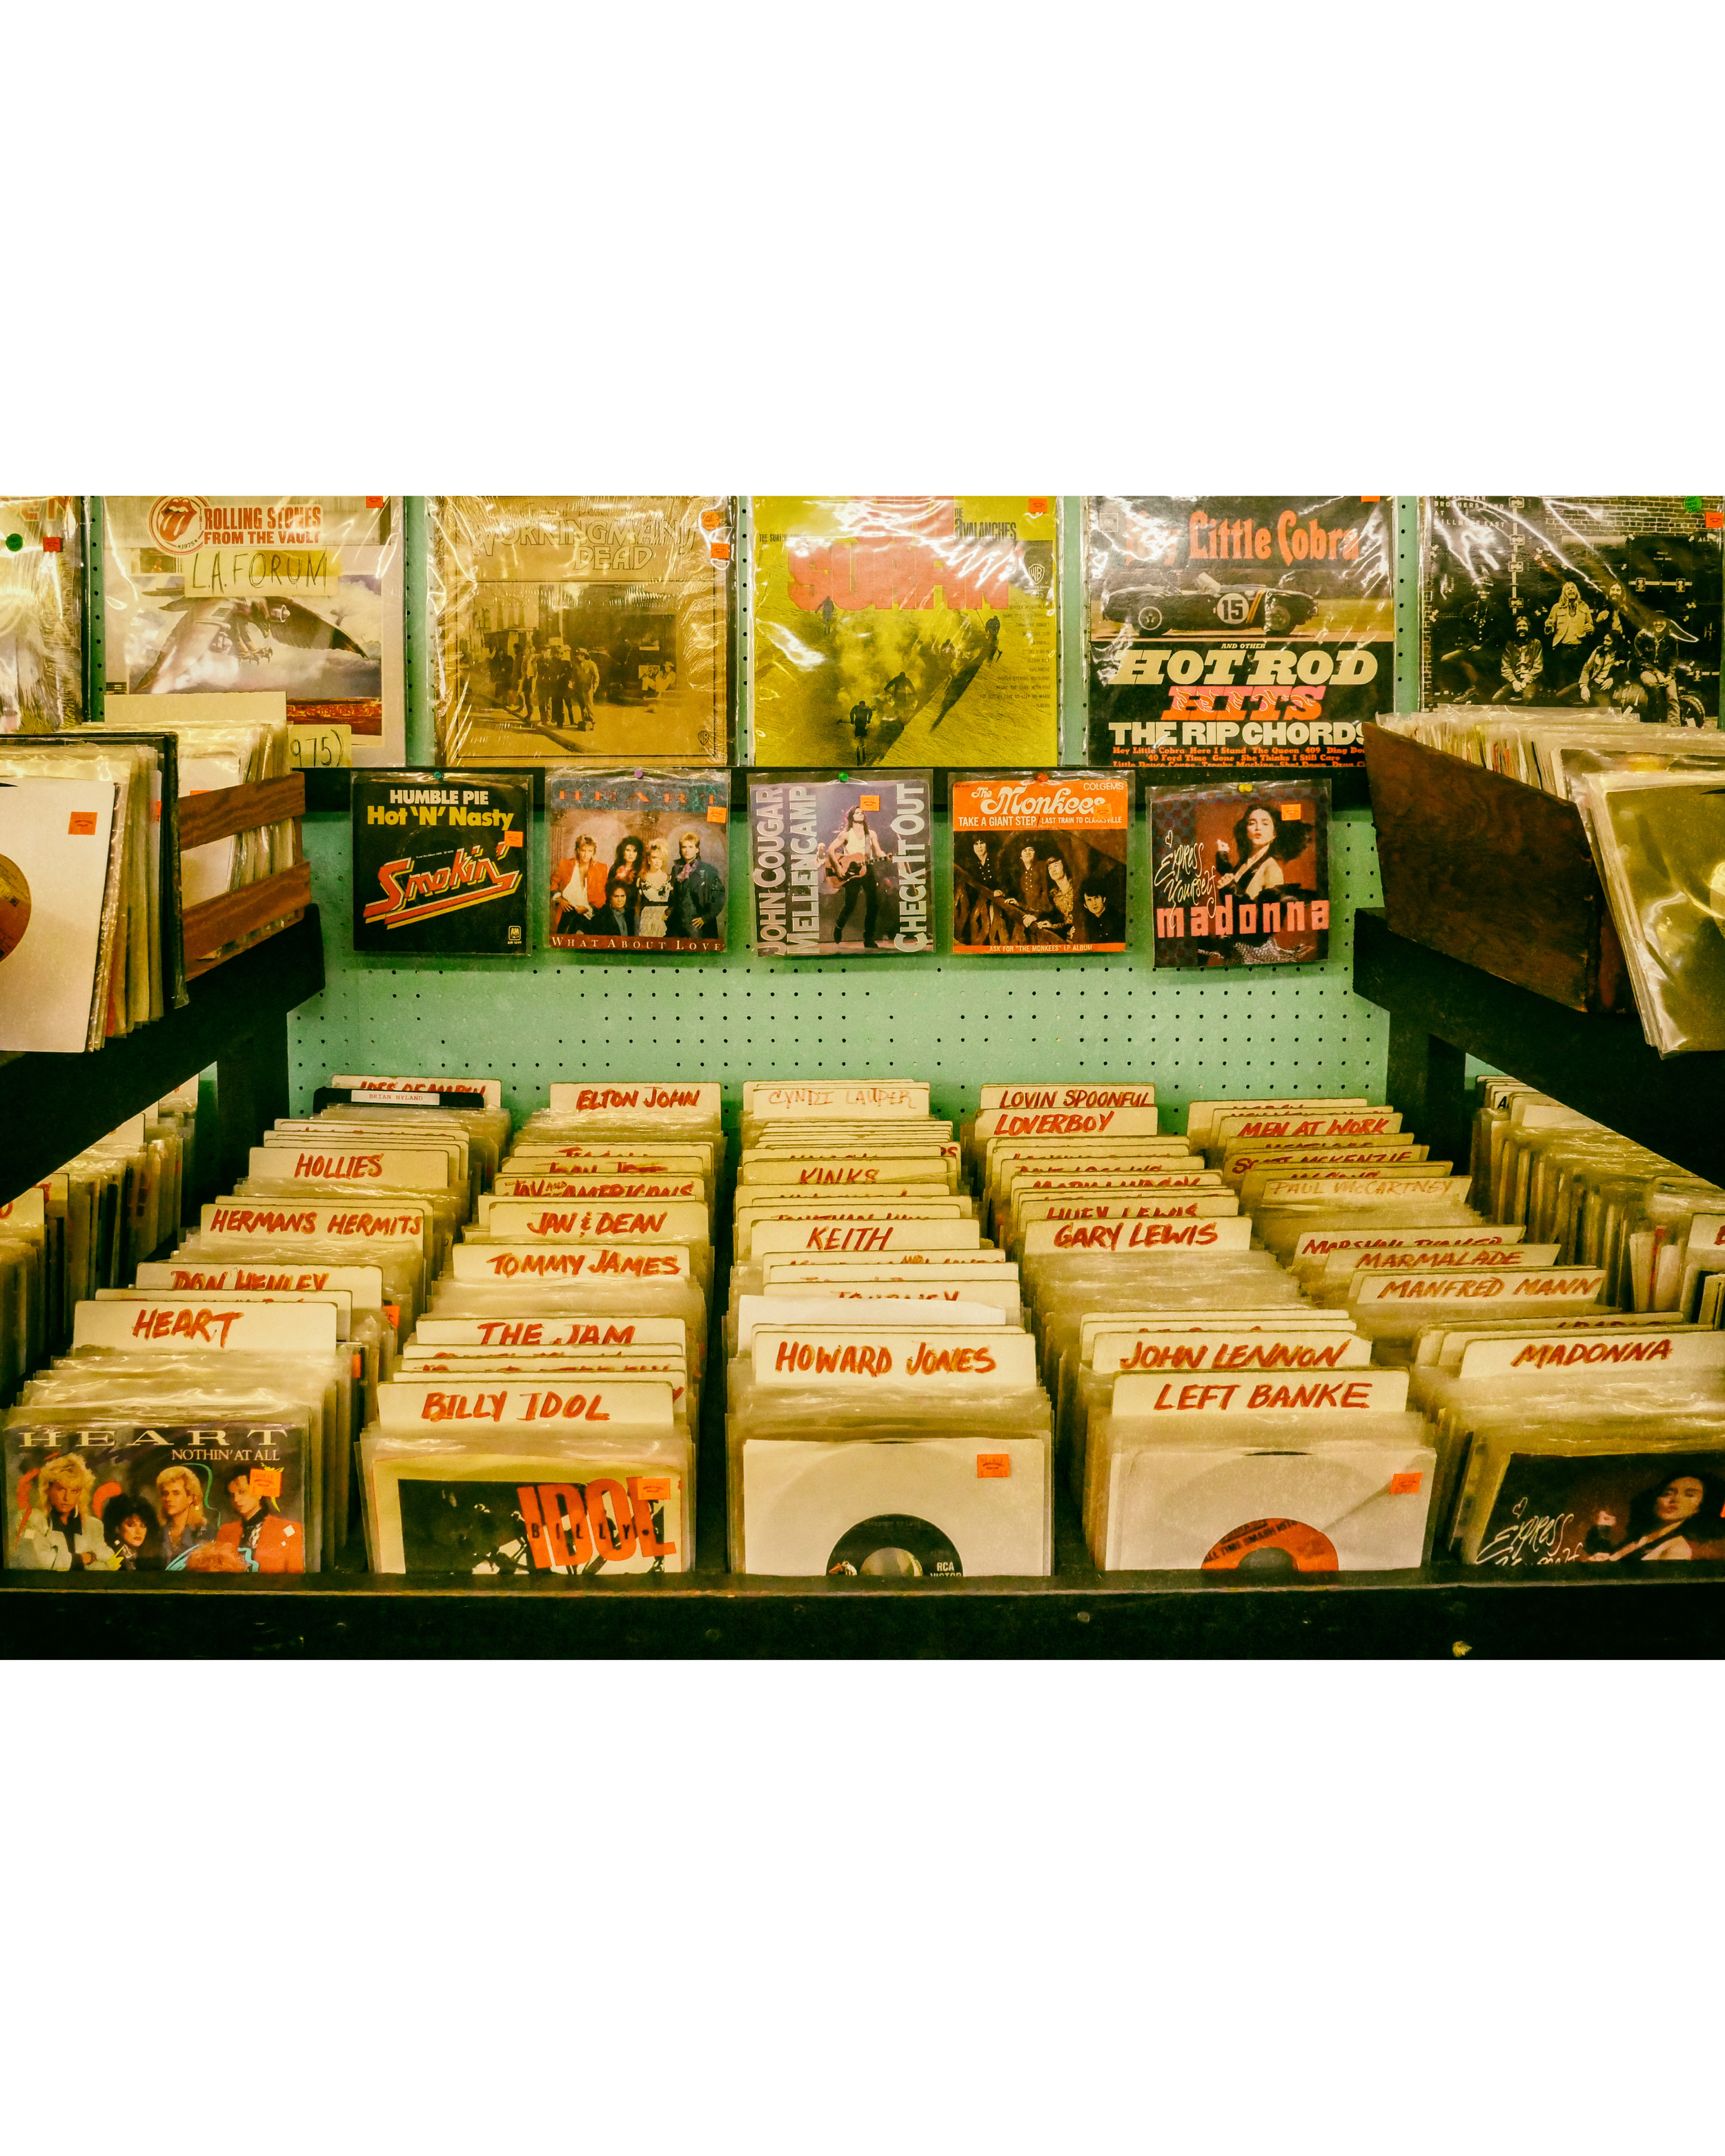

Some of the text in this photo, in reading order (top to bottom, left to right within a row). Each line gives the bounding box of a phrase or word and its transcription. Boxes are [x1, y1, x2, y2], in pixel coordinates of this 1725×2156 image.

[204, 506, 322, 531] ROLLING STONES
[954, 508, 963, 518] THE
[204, 530, 321, 545] FROM THE VAULT
[759, 533, 768, 542] THE
[1189, 509, 1359, 566] Little Cobra
[191, 546, 328, 594] L.A. FORUM
[573, 546, 653, 571] DEAD
[1222, 600, 1243, 621] 15
[1107, 649, 1379, 685] HOT ROD
[1160, 685, 1326, 722] HITS
[1108, 722, 1177, 746] THE
[1182, 722, 1241, 746] RIP
[1113, 746, 1130, 755] Hey
[1271, 746, 1300, 755] Queen
[1326, 746, 1348, 755] Ding
[389, 789, 489, 806] HUMBLE PIE
[559, 790, 724, 804] HEART
[971, 787, 993, 798] The
[1083, 782, 1124, 791] COLGEMS
[980, 786, 1106, 815] Monkees
[366, 805, 408, 826] Hot
[448, 806, 514, 831] Nasty
[958, 816, 979, 827] TAKE
[980, 816, 987, 826] A
[989, 816, 1014, 826] GIANT
[753, 787, 787, 956] JOHN COUGAR
[787, 785, 820, 955] MELLENCAMP
[891, 784, 928, 953] CHECK IT OUT
[1156, 894, 1330, 938] madonna
[551, 936, 722, 951] WHAT ABOUT LOVE
[575, 1086, 701, 1111] ELTON JOHN
[768, 1088, 917, 1109] CYNDI LAUPER
[999, 1089, 1155, 1109] LOVIN SPOONFUL
[994, 1110, 1115, 1136] LOVERBOY
[1237, 1118, 1390, 1137] MEN AT WORK
[294, 1153, 384, 1180] HOLLIES
[799, 1167, 880, 1185] KINKS
[1269, 1179, 1327, 1196] PAUL
[210, 1208, 424, 1237] HERMANS HERMITS
[526, 1210, 669, 1238] JAN & DEAN
[805, 1225, 894, 1252] KEITH
[1053, 1221, 1219, 1252] GARY LEWIS
[486, 1248, 682, 1278] TOMMY JAMES
[1354, 1249, 1525, 1269] MARMALADE
[1377, 1276, 1603, 1300] MANFRED MANN
[131, 1307, 245, 1348] HEART
[477, 1321, 636, 1346] THE JAM
[774, 1340, 998, 1378] HOWARD JONES
[1119, 1338, 1352, 1370] JOHN LENNON
[1509, 1338, 1673, 1369] MADONNA
[421, 1390, 611, 1423] BILLY IDOL
[1153, 1381, 1374, 1411] LEFT BANKE
[18, 1429, 288, 1448] HEART
[171, 1449, 281, 1461] NOTHIN' AT ALL
[516, 1476, 678, 1570] IDOL
[531, 1522, 631, 1540] BILLY
[936, 1561, 955, 1572] RCA
